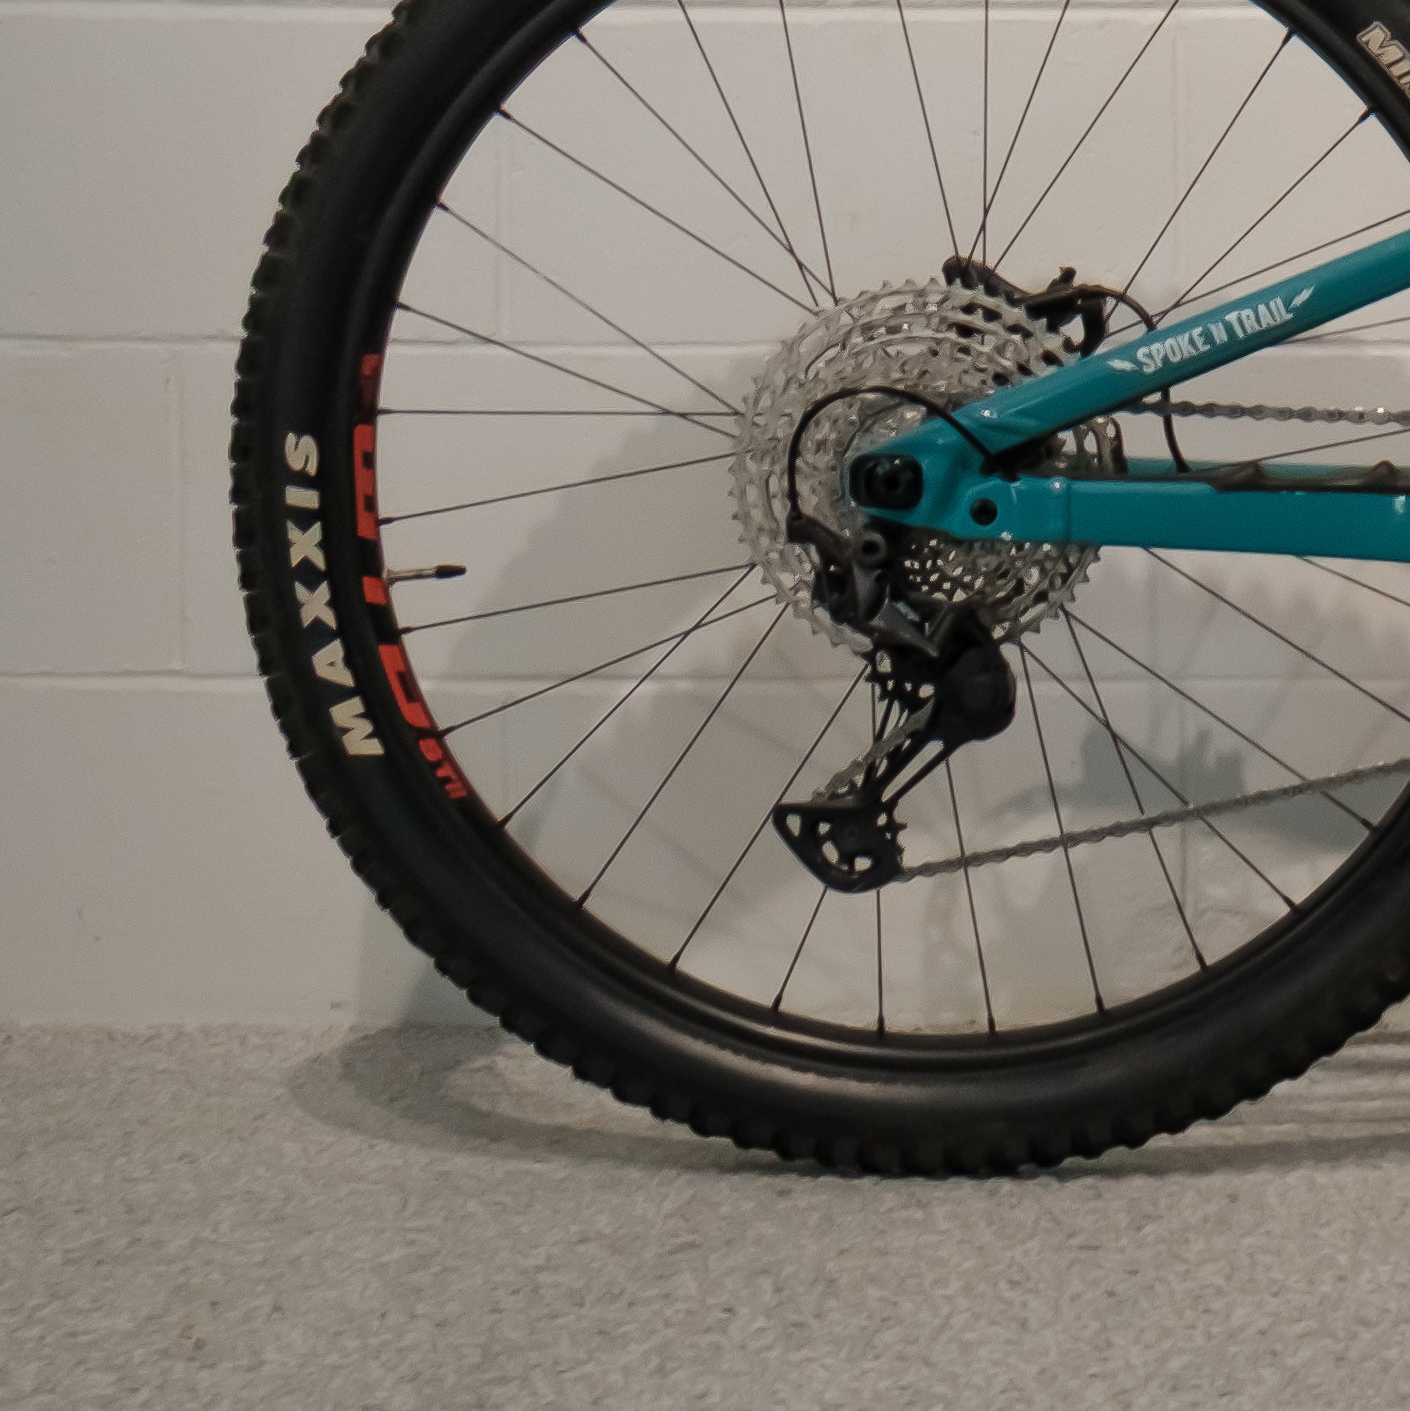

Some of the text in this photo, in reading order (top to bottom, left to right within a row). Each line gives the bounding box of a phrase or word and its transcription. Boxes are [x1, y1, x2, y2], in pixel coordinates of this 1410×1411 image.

[1136, 326, 1210, 374] SPOKE
[1224, 296, 1294, 339] TRAIL
[284, 432, 385, 758] MAXXIS
